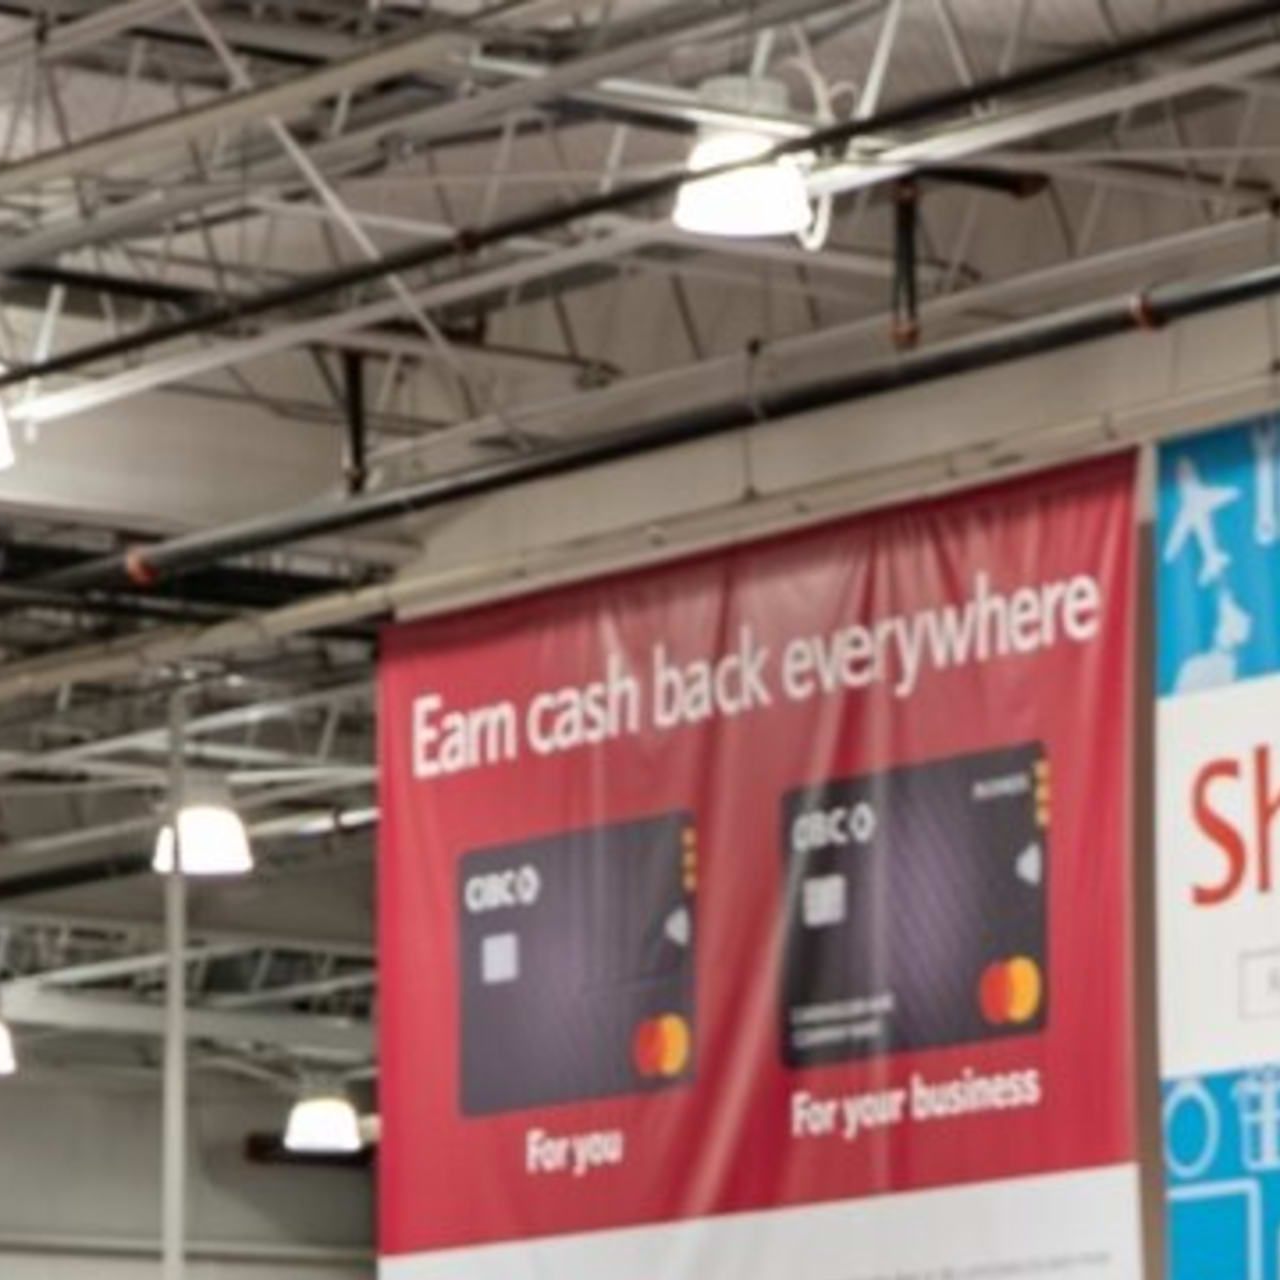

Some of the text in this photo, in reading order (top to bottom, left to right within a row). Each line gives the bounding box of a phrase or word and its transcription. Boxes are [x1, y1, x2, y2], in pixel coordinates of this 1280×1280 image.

[412, 571, 1102, 778] Earn cash back everywhere
[791, 1069, 1041, 1140] For your business
[526, 1129, 623, 1178] For you
